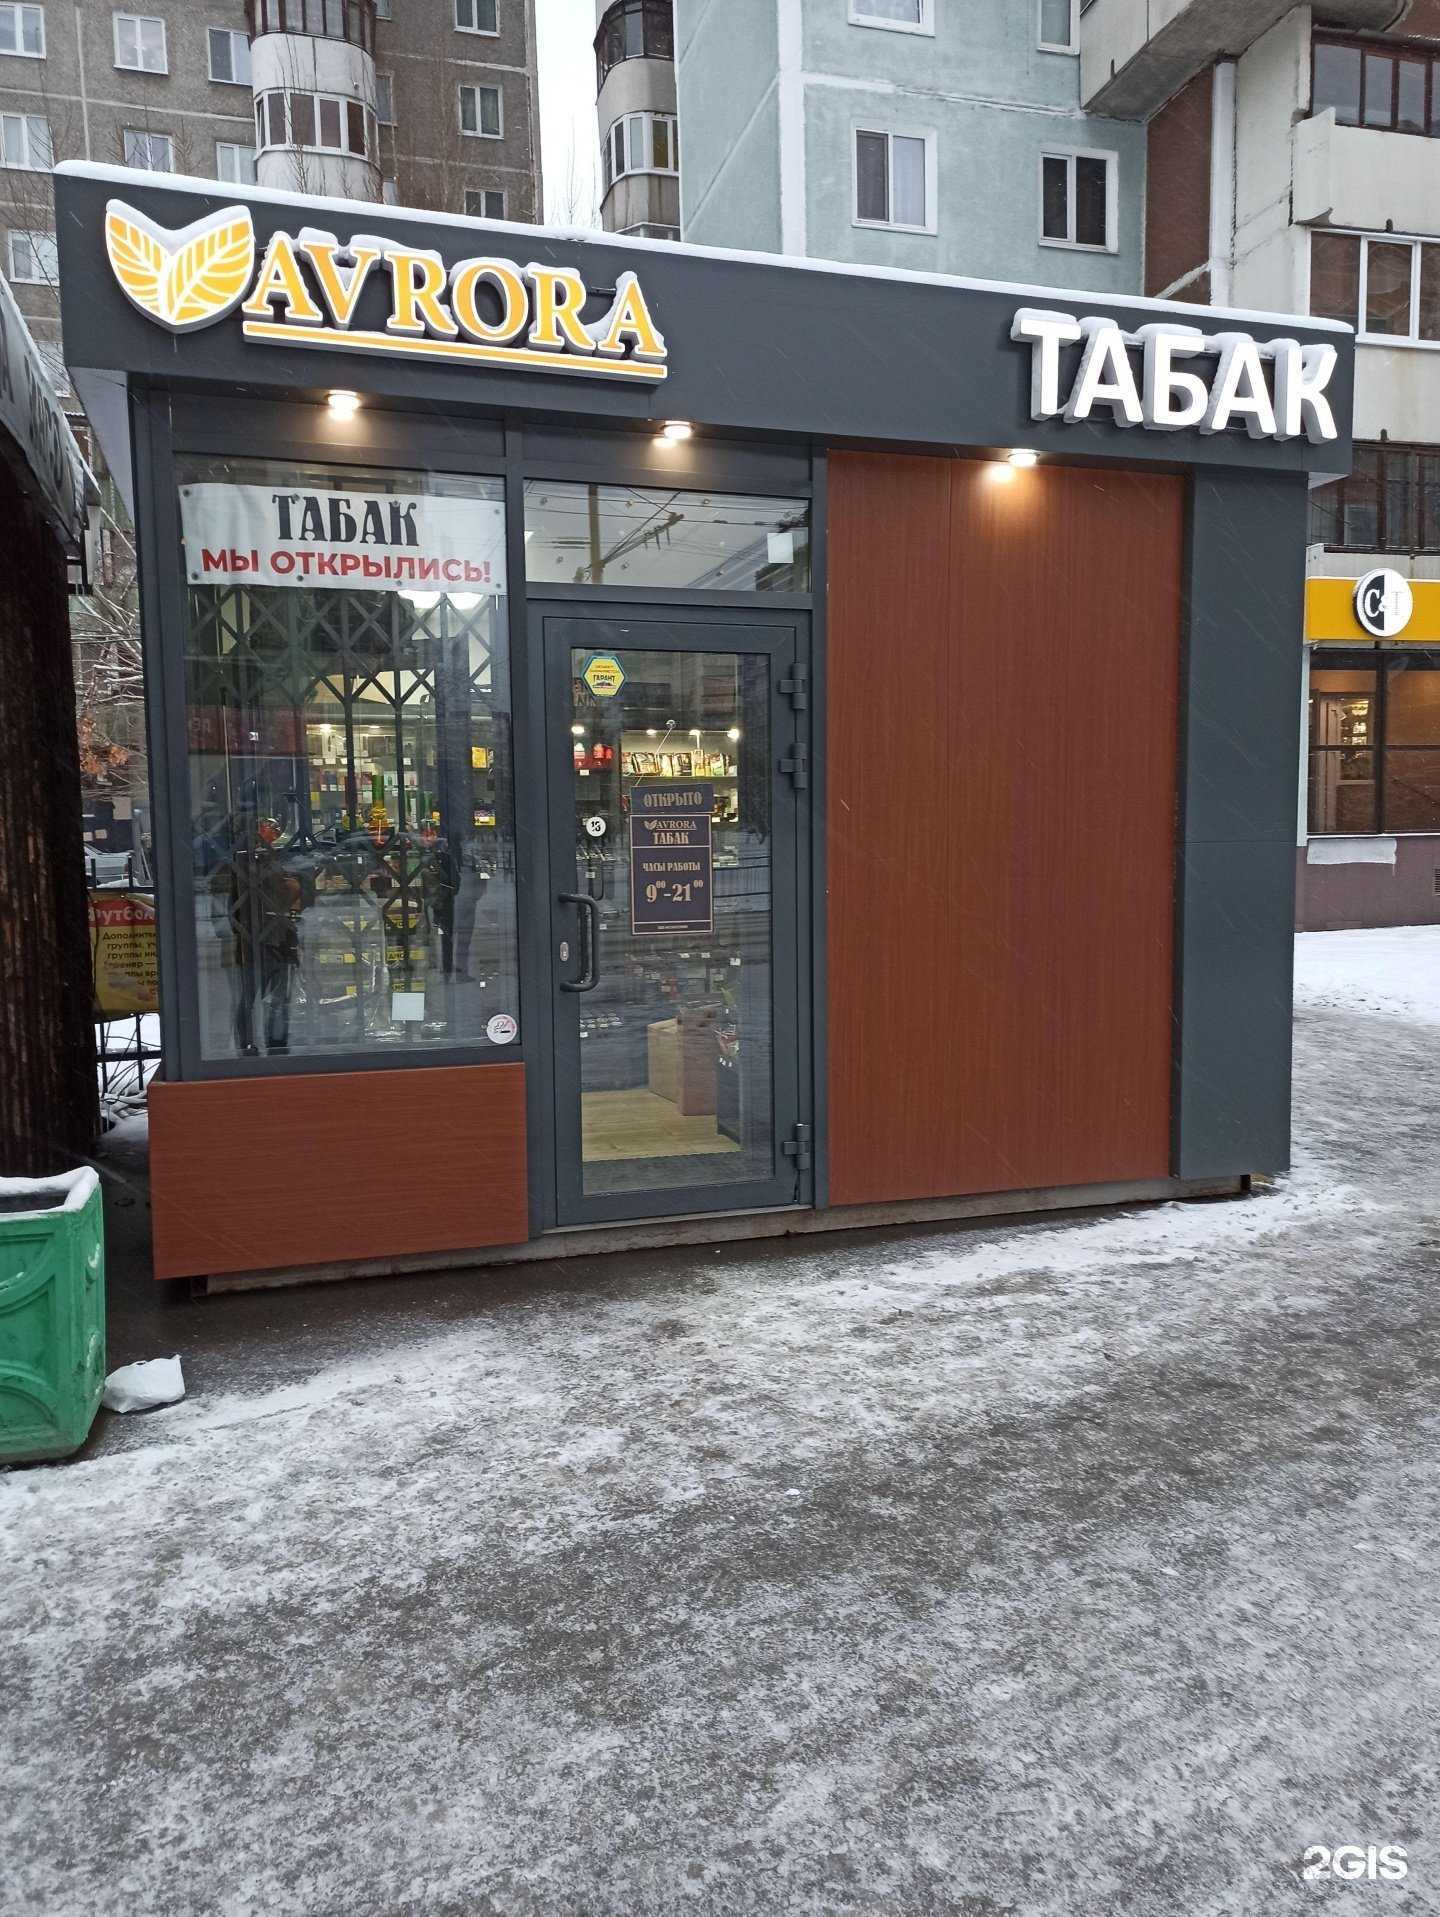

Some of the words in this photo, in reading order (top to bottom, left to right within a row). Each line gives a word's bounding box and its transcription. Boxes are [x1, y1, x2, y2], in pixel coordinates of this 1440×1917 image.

[242, 231, 668, 362] AVRORA
[1012, 312, 1338, 443] ТАБАК
[272, 494, 419, 547] ТАБАК
[202, 548, 259, 572] МЫ
[270, 550, 491, 584] ОТКРЫЛИСЬ!
[643, 791, 703, 808] ОТКРЫТО
[655, 820, 697, 829] AVRORA
[653, 832, 690, 845] ТАБАК
[642, 862, 666, 872] ЧАСЫ
[667, 861, 701, 871] РАБОТЫ
